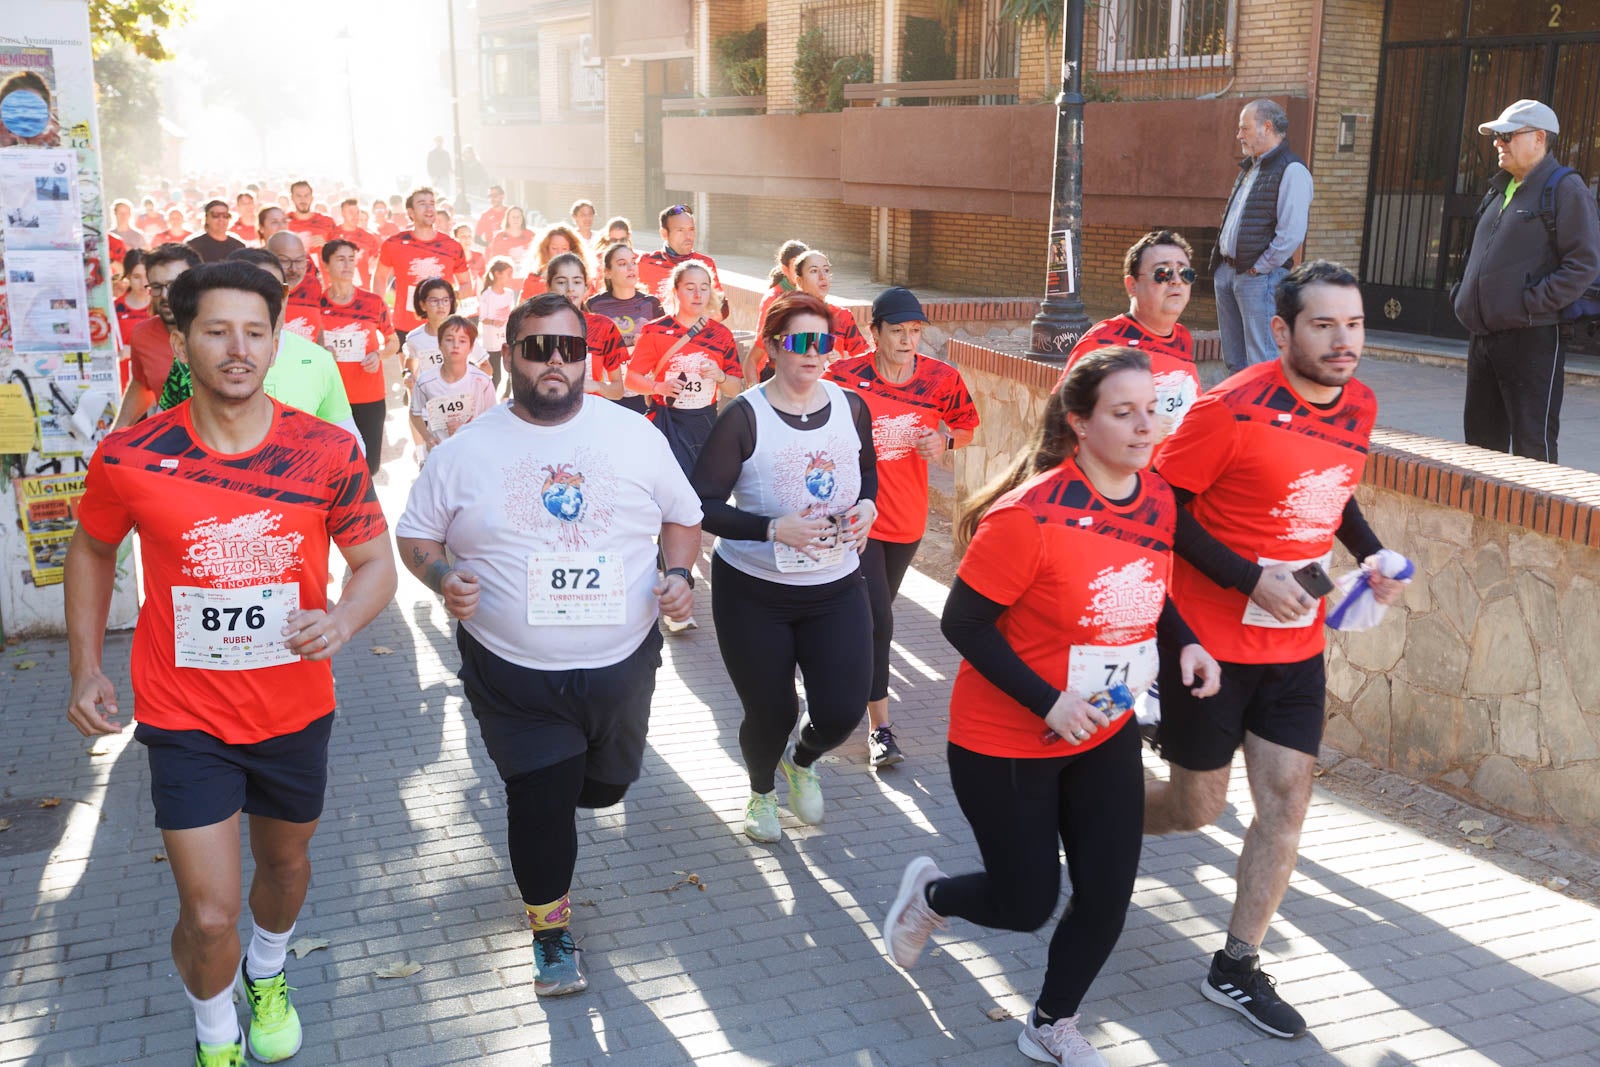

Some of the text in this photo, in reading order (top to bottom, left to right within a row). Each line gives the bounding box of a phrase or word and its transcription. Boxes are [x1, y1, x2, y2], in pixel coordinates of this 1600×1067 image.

[1548, 4, 1561, 27] 2
[332, 339, 353, 348] 151
[680, 381, 702, 393] 43
[438, 401, 464, 414] 149
[551, 568, 601, 590] 872
[202, 605, 266, 632] 876
[223, 635, 253, 644] RUBEN
[1104, 661, 1131, 686] 71
